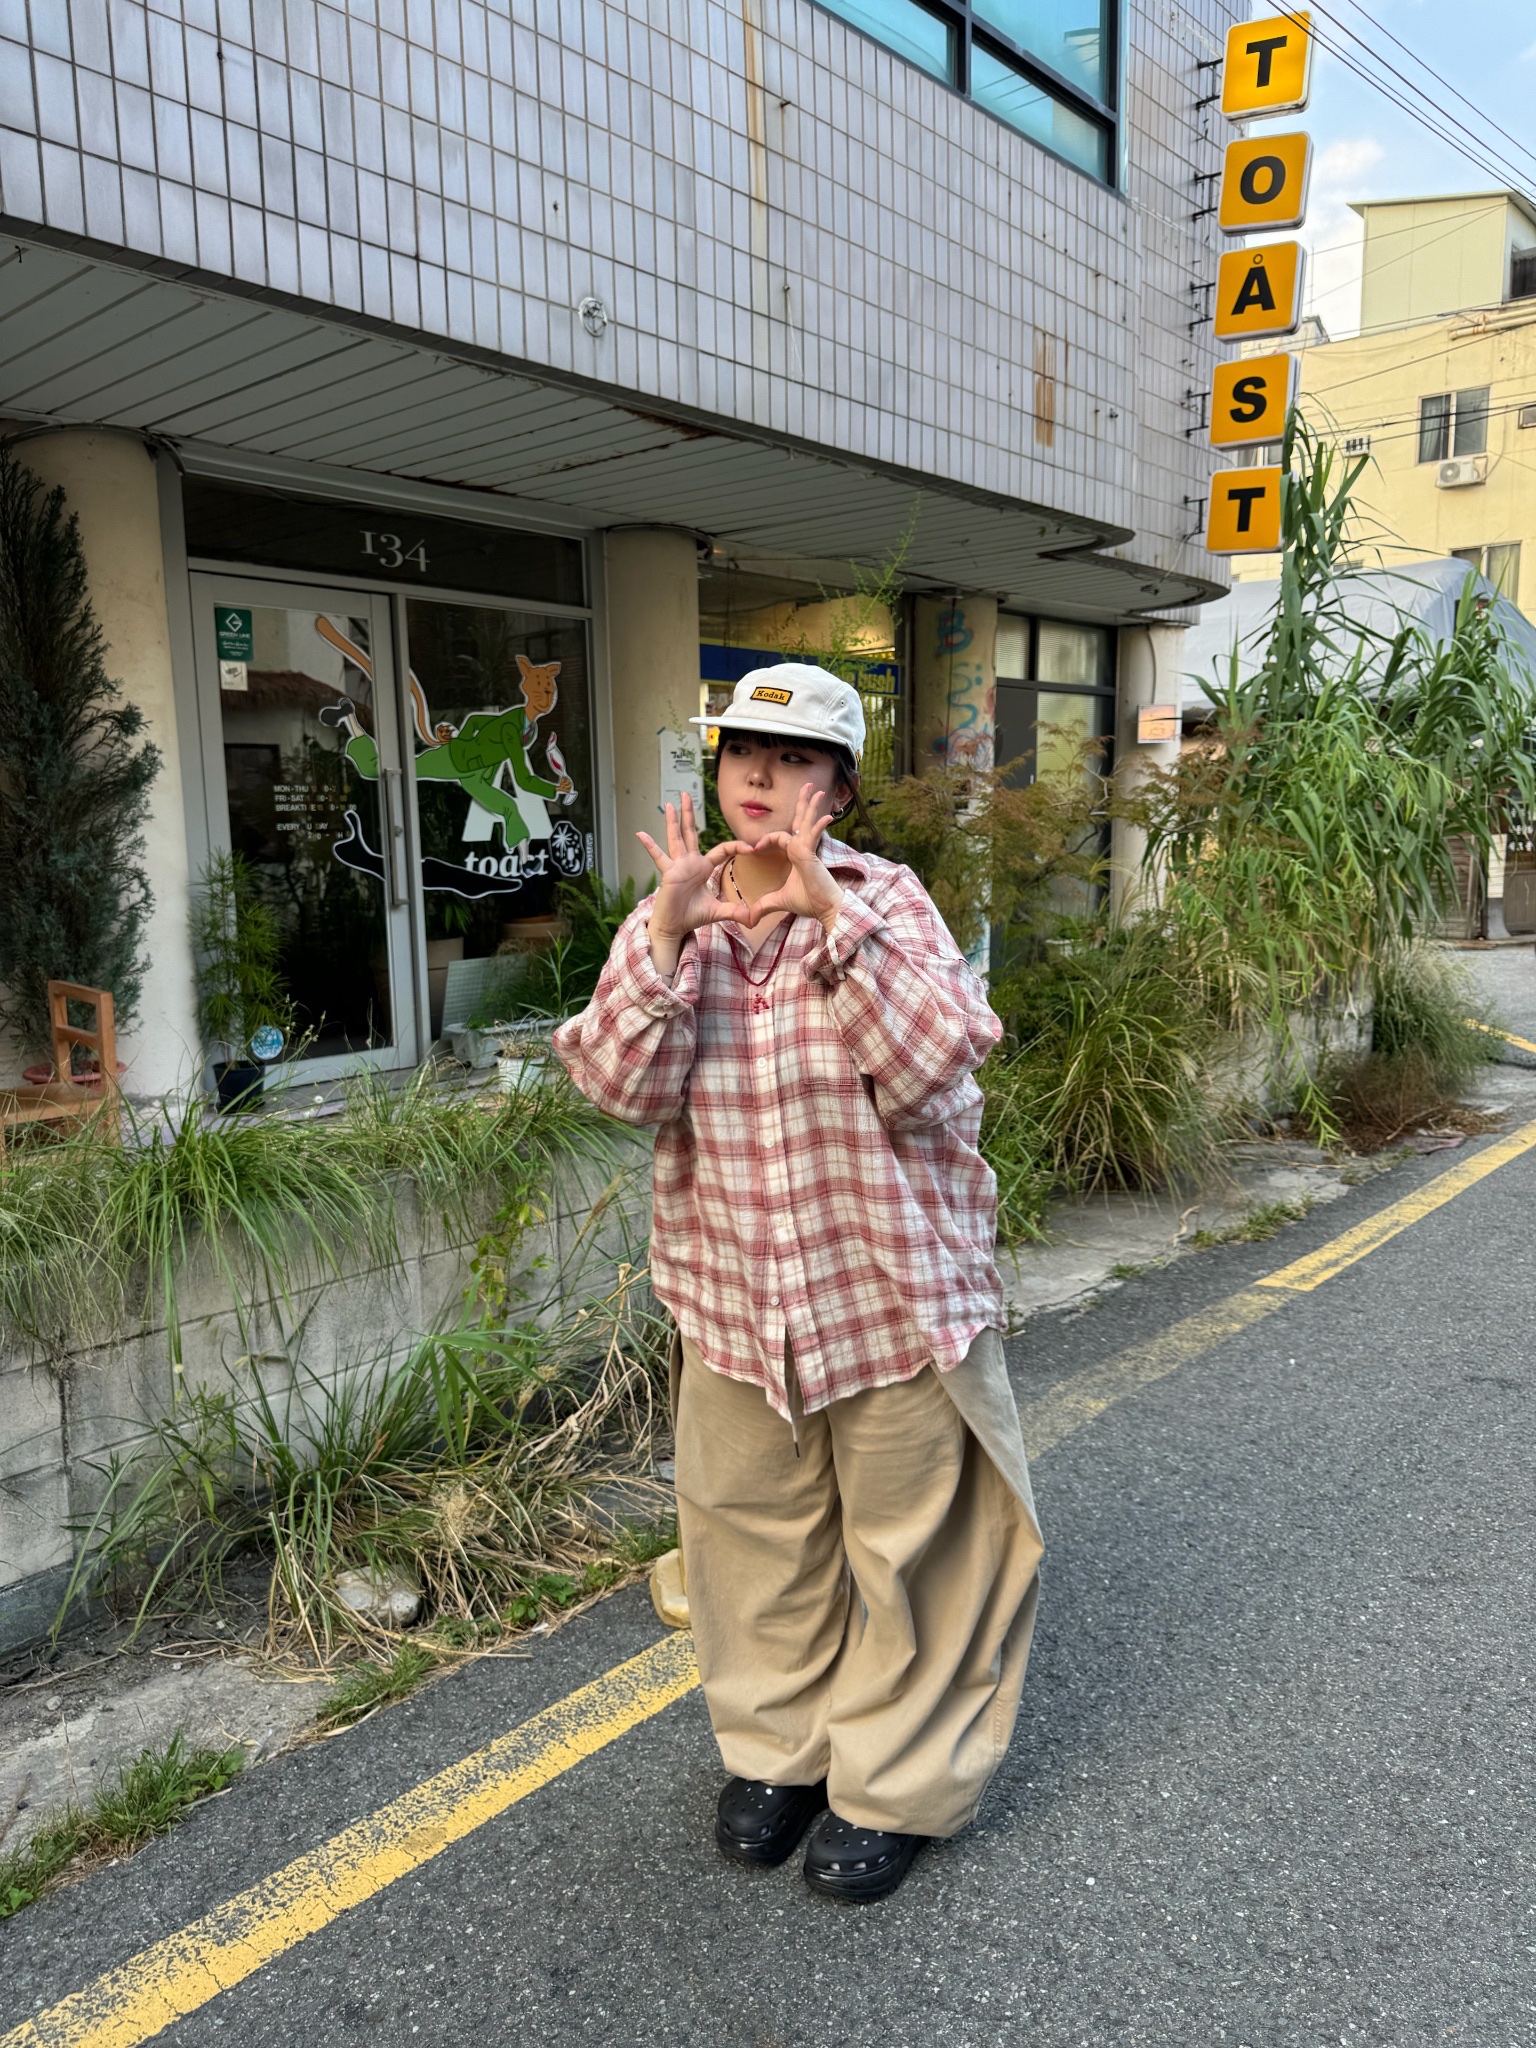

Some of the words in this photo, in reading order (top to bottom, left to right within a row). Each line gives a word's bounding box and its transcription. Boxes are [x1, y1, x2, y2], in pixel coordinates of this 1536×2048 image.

[359, 530, 431, 572] 134
[756, 690, 786, 701] Kodak
[275, 803, 316, 811] BREAKTIE
